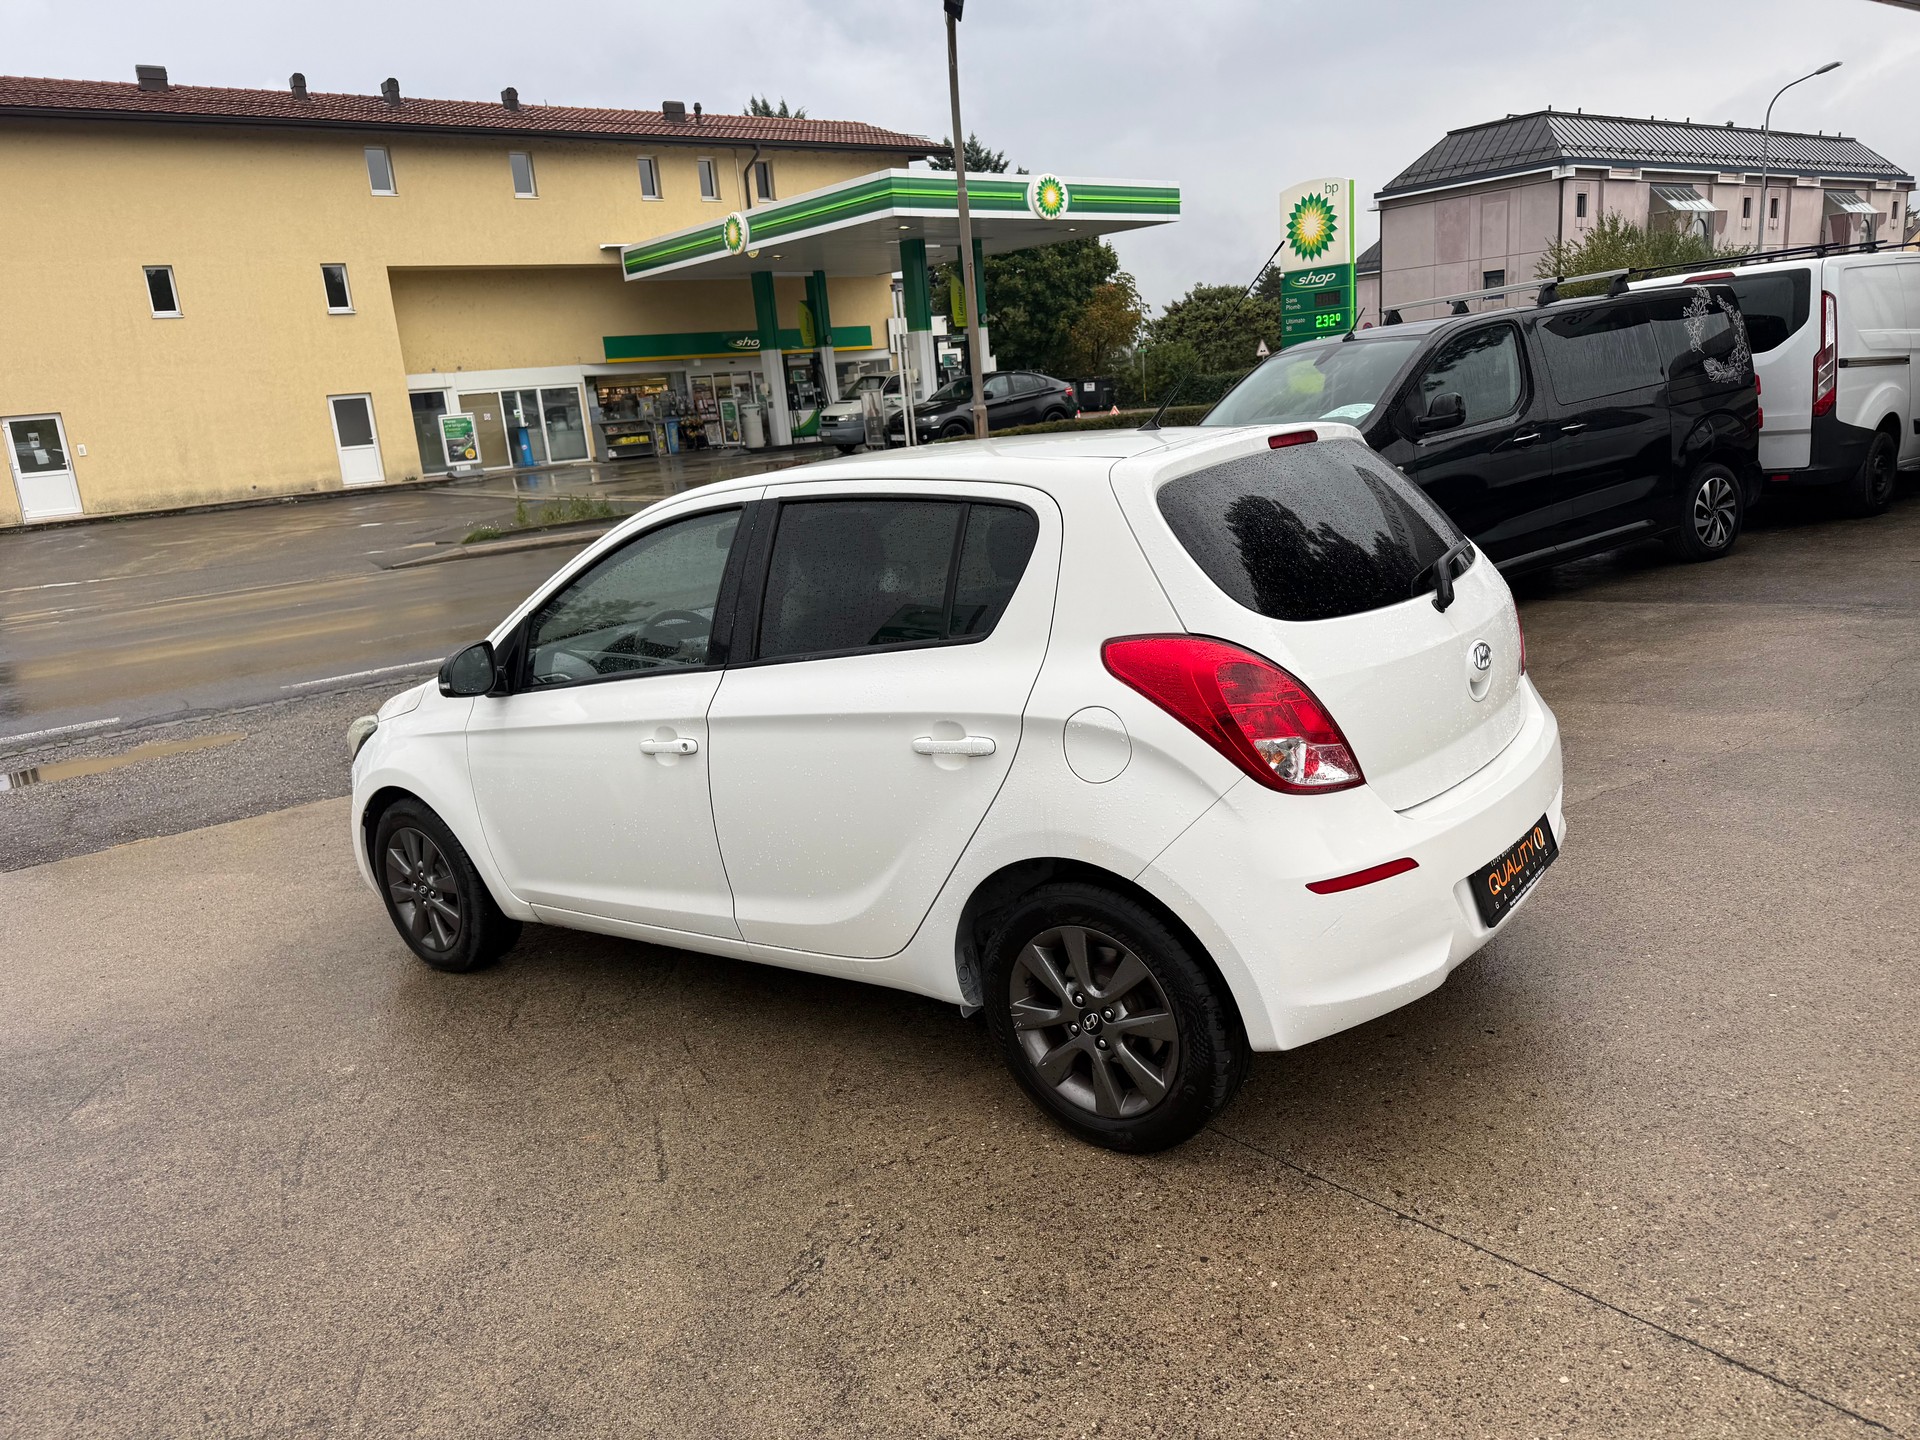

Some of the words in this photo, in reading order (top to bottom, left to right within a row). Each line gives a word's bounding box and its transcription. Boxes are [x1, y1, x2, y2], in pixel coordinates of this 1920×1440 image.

[1325, 182, 1338, 196] bp
[1299, 271, 1336, 287] shop
[737, 337, 760, 349] sho
[1495, 848, 1548, 910] GARANTIE
